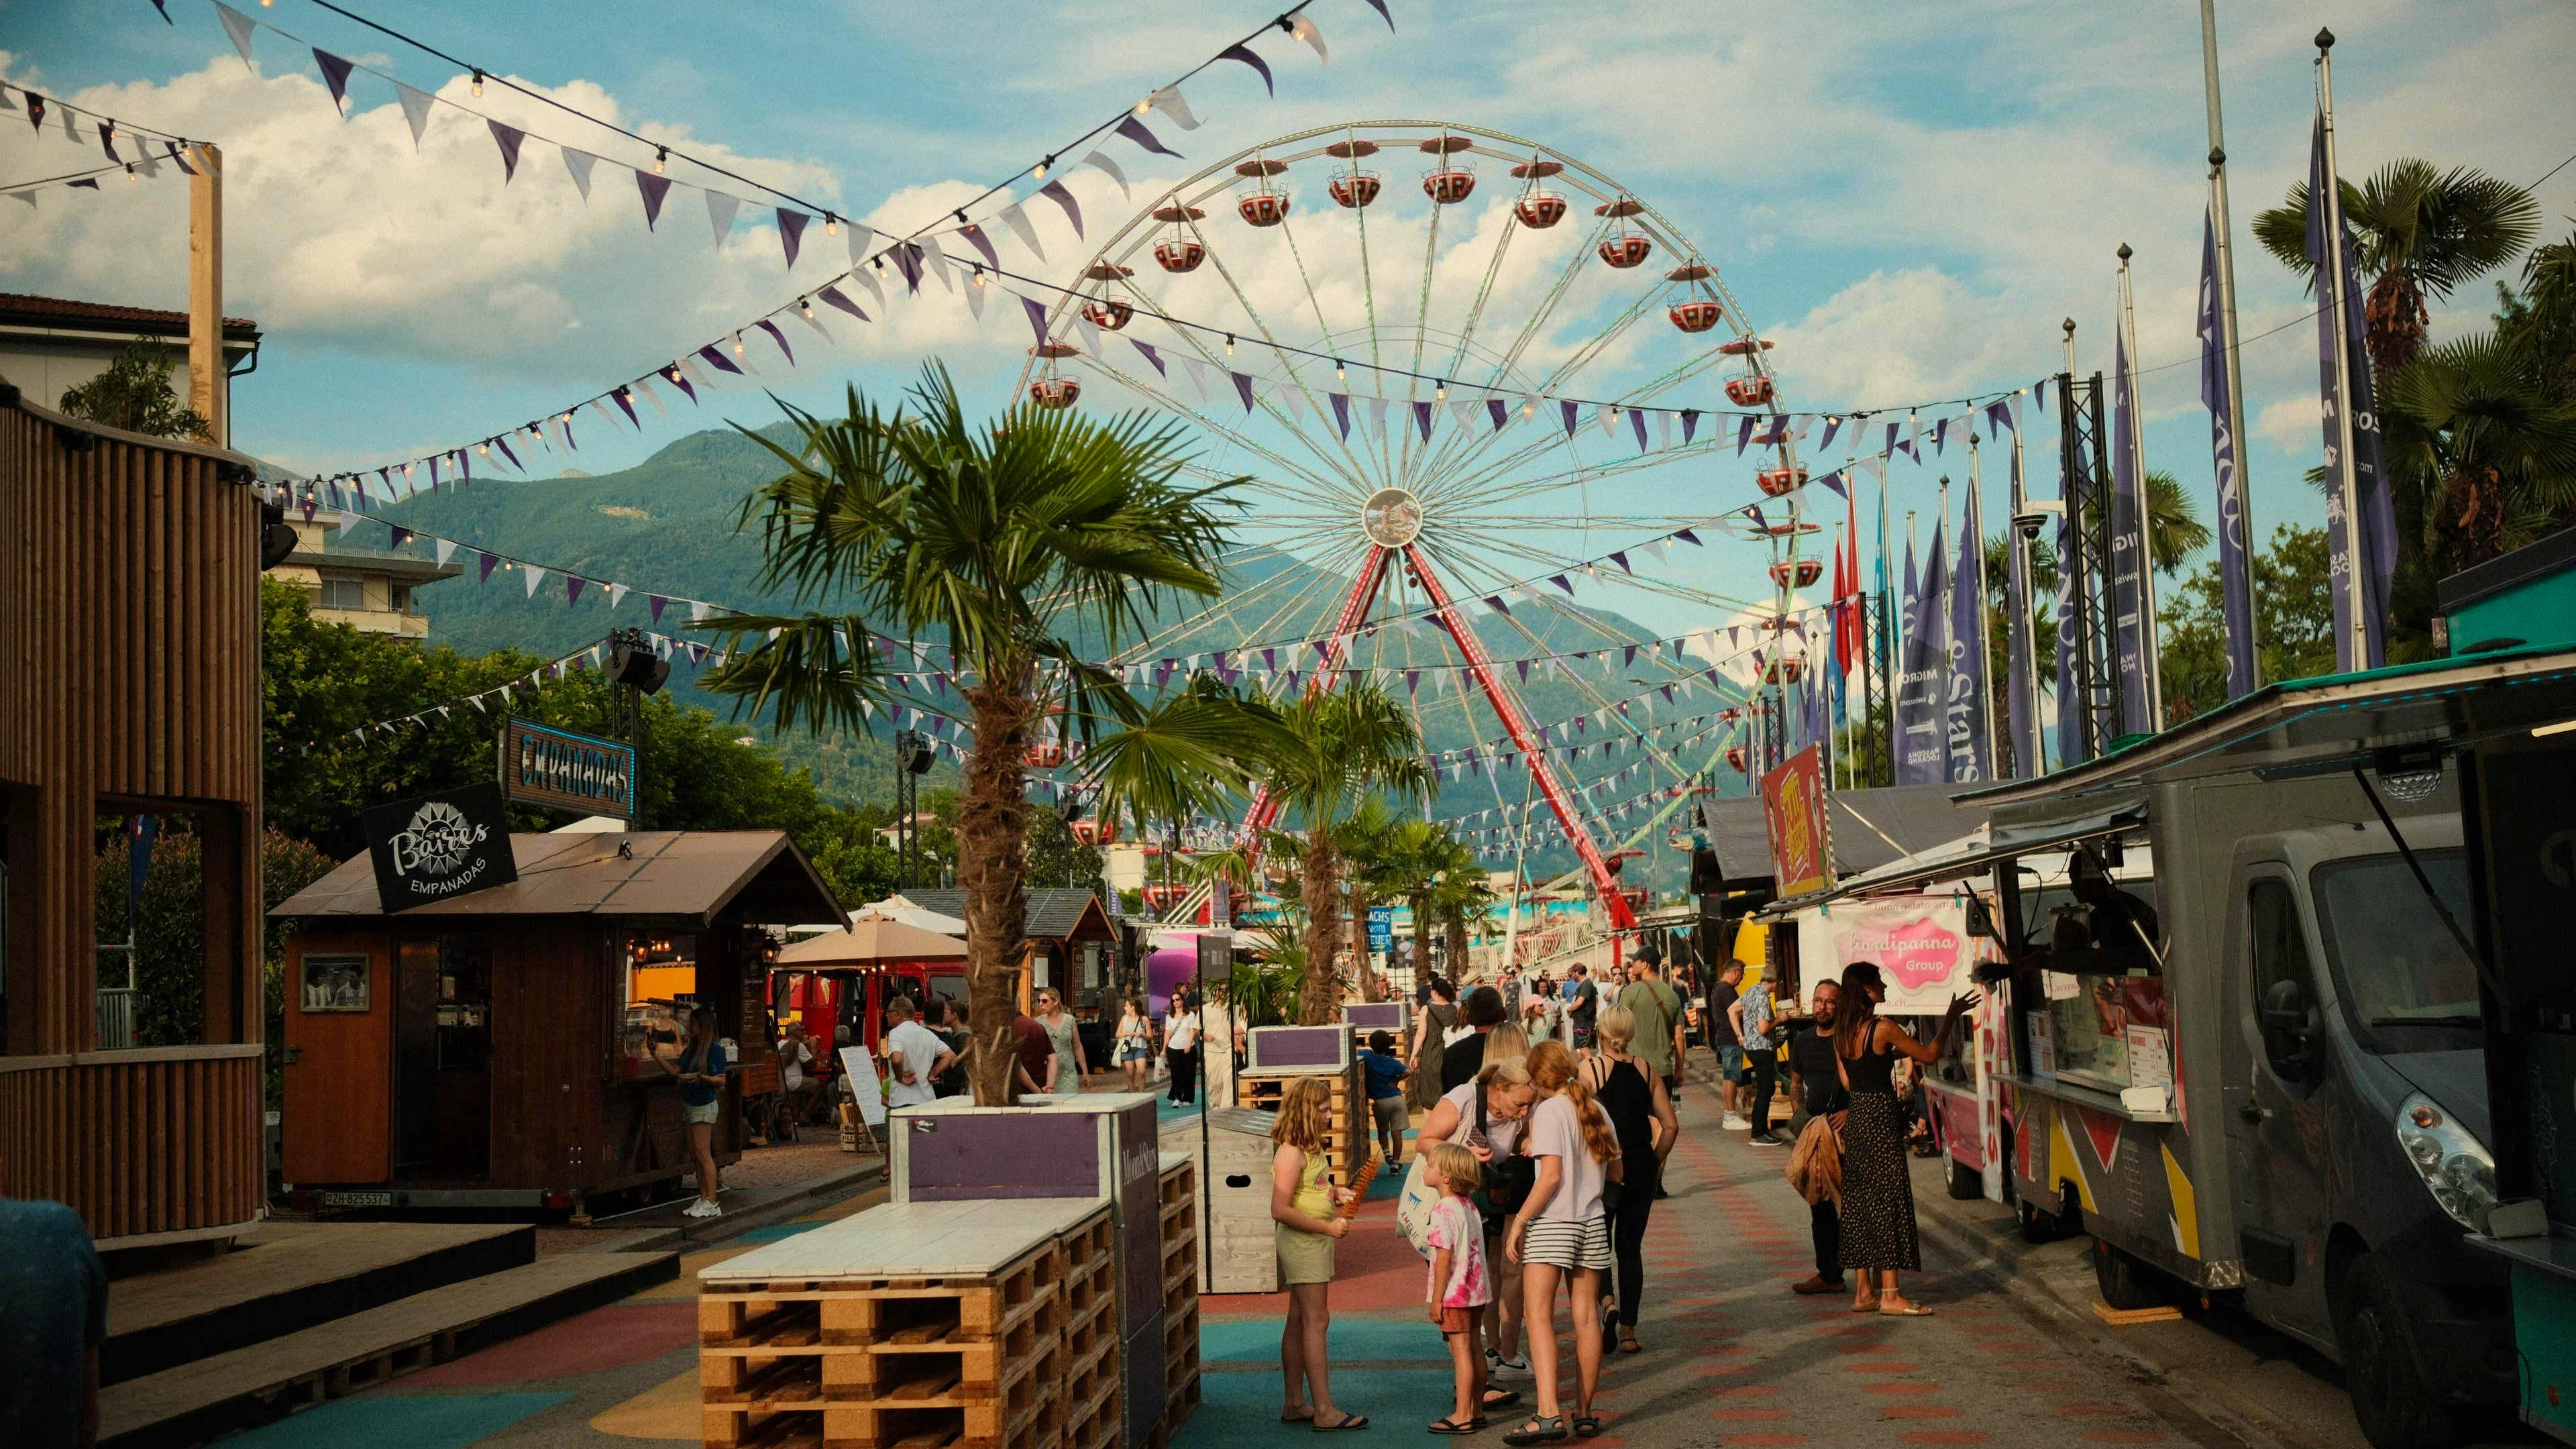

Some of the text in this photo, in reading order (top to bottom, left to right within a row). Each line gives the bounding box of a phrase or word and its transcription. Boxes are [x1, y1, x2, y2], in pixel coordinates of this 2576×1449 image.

[521, 733, 628, 803] EMPANADAS
[388, 822, 490, 876] Baires
[411, 857, 487, 894] EMPANADAS
[1901, 900, 1930, 912] gelato
[1933, 900, 1956, 910] artig
[1906, 961, 1943, 971] Group
[1401, 1212, 1419, 1242] AMELIE
